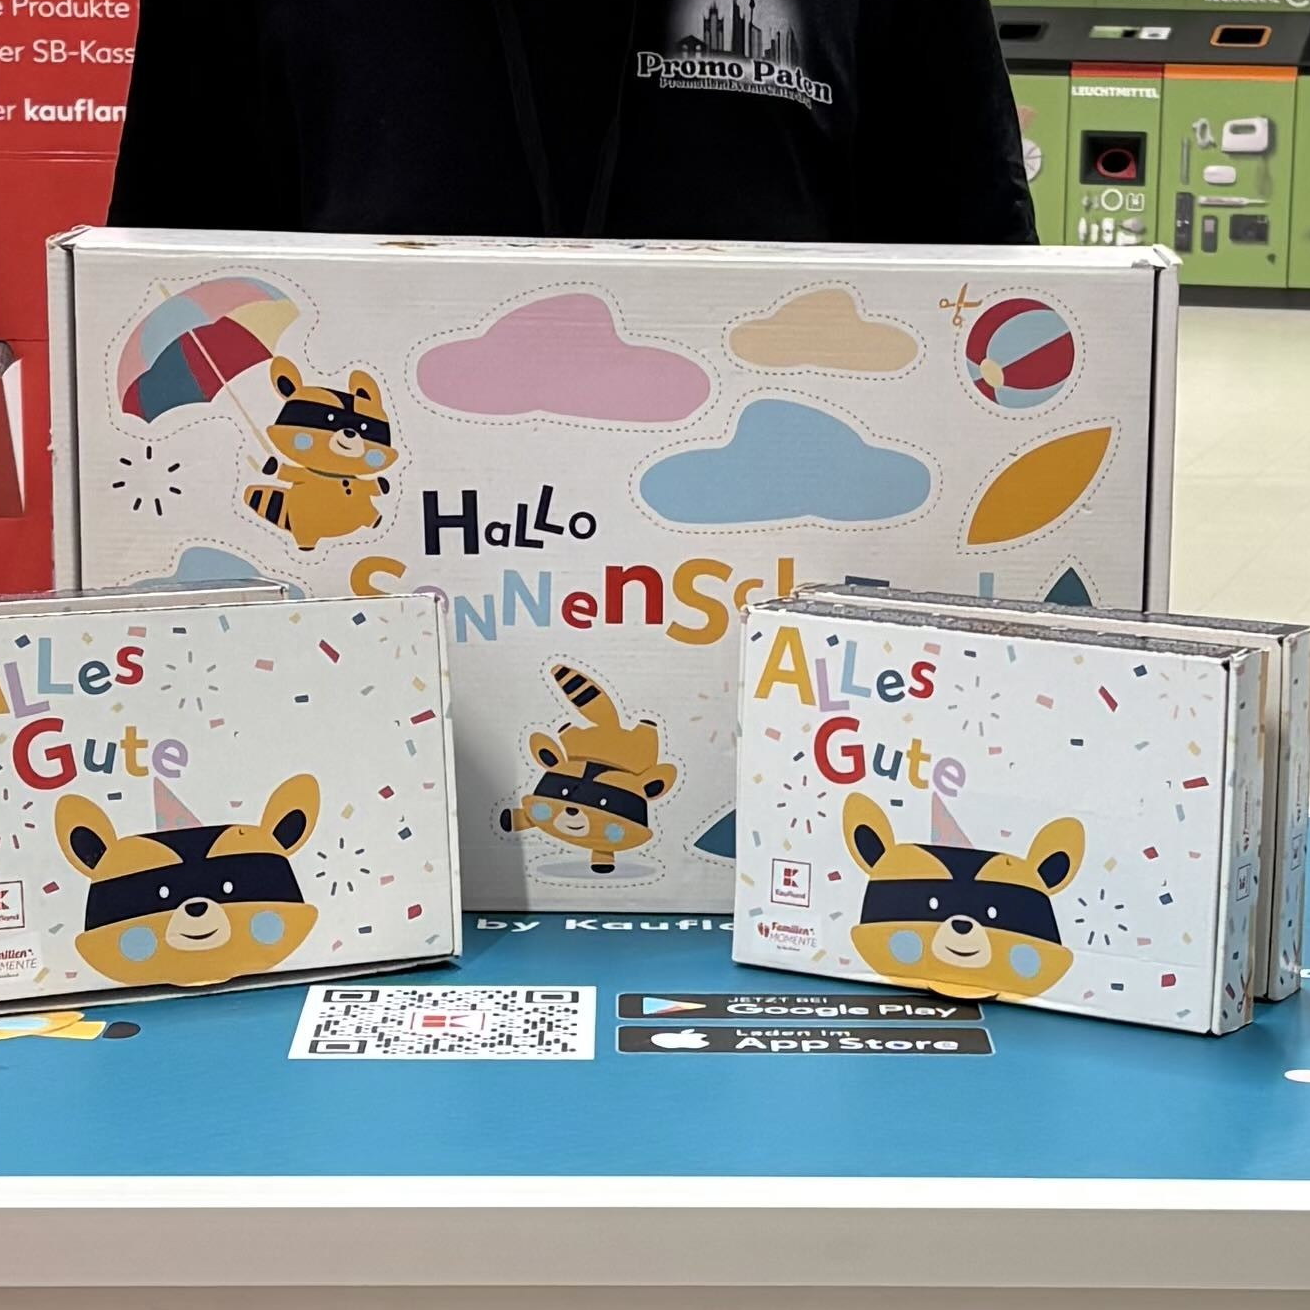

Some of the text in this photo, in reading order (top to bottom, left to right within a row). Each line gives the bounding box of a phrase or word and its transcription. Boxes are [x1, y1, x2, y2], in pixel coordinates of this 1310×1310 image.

[32, 40, 136, 65] SB-Kass
[637, 52, 744, 79] Promo
[751, 58, 833, 104] Paten
[1071, 85, 1160, 100] LEUCHTMITTEL
[24, 98, 127, 123] kauflan
[12, 716, 189, 791] Gute
[813, 715, 966, 798] Gute
[476, 918, 734, 933] by Kaufl
[771, 921, 809, 935] Familien
[769, 932, 817, 948] MOMENTE
[726, 1003, 957, 1018] Google Play
[735, 1037, 959, 1052] App Store
